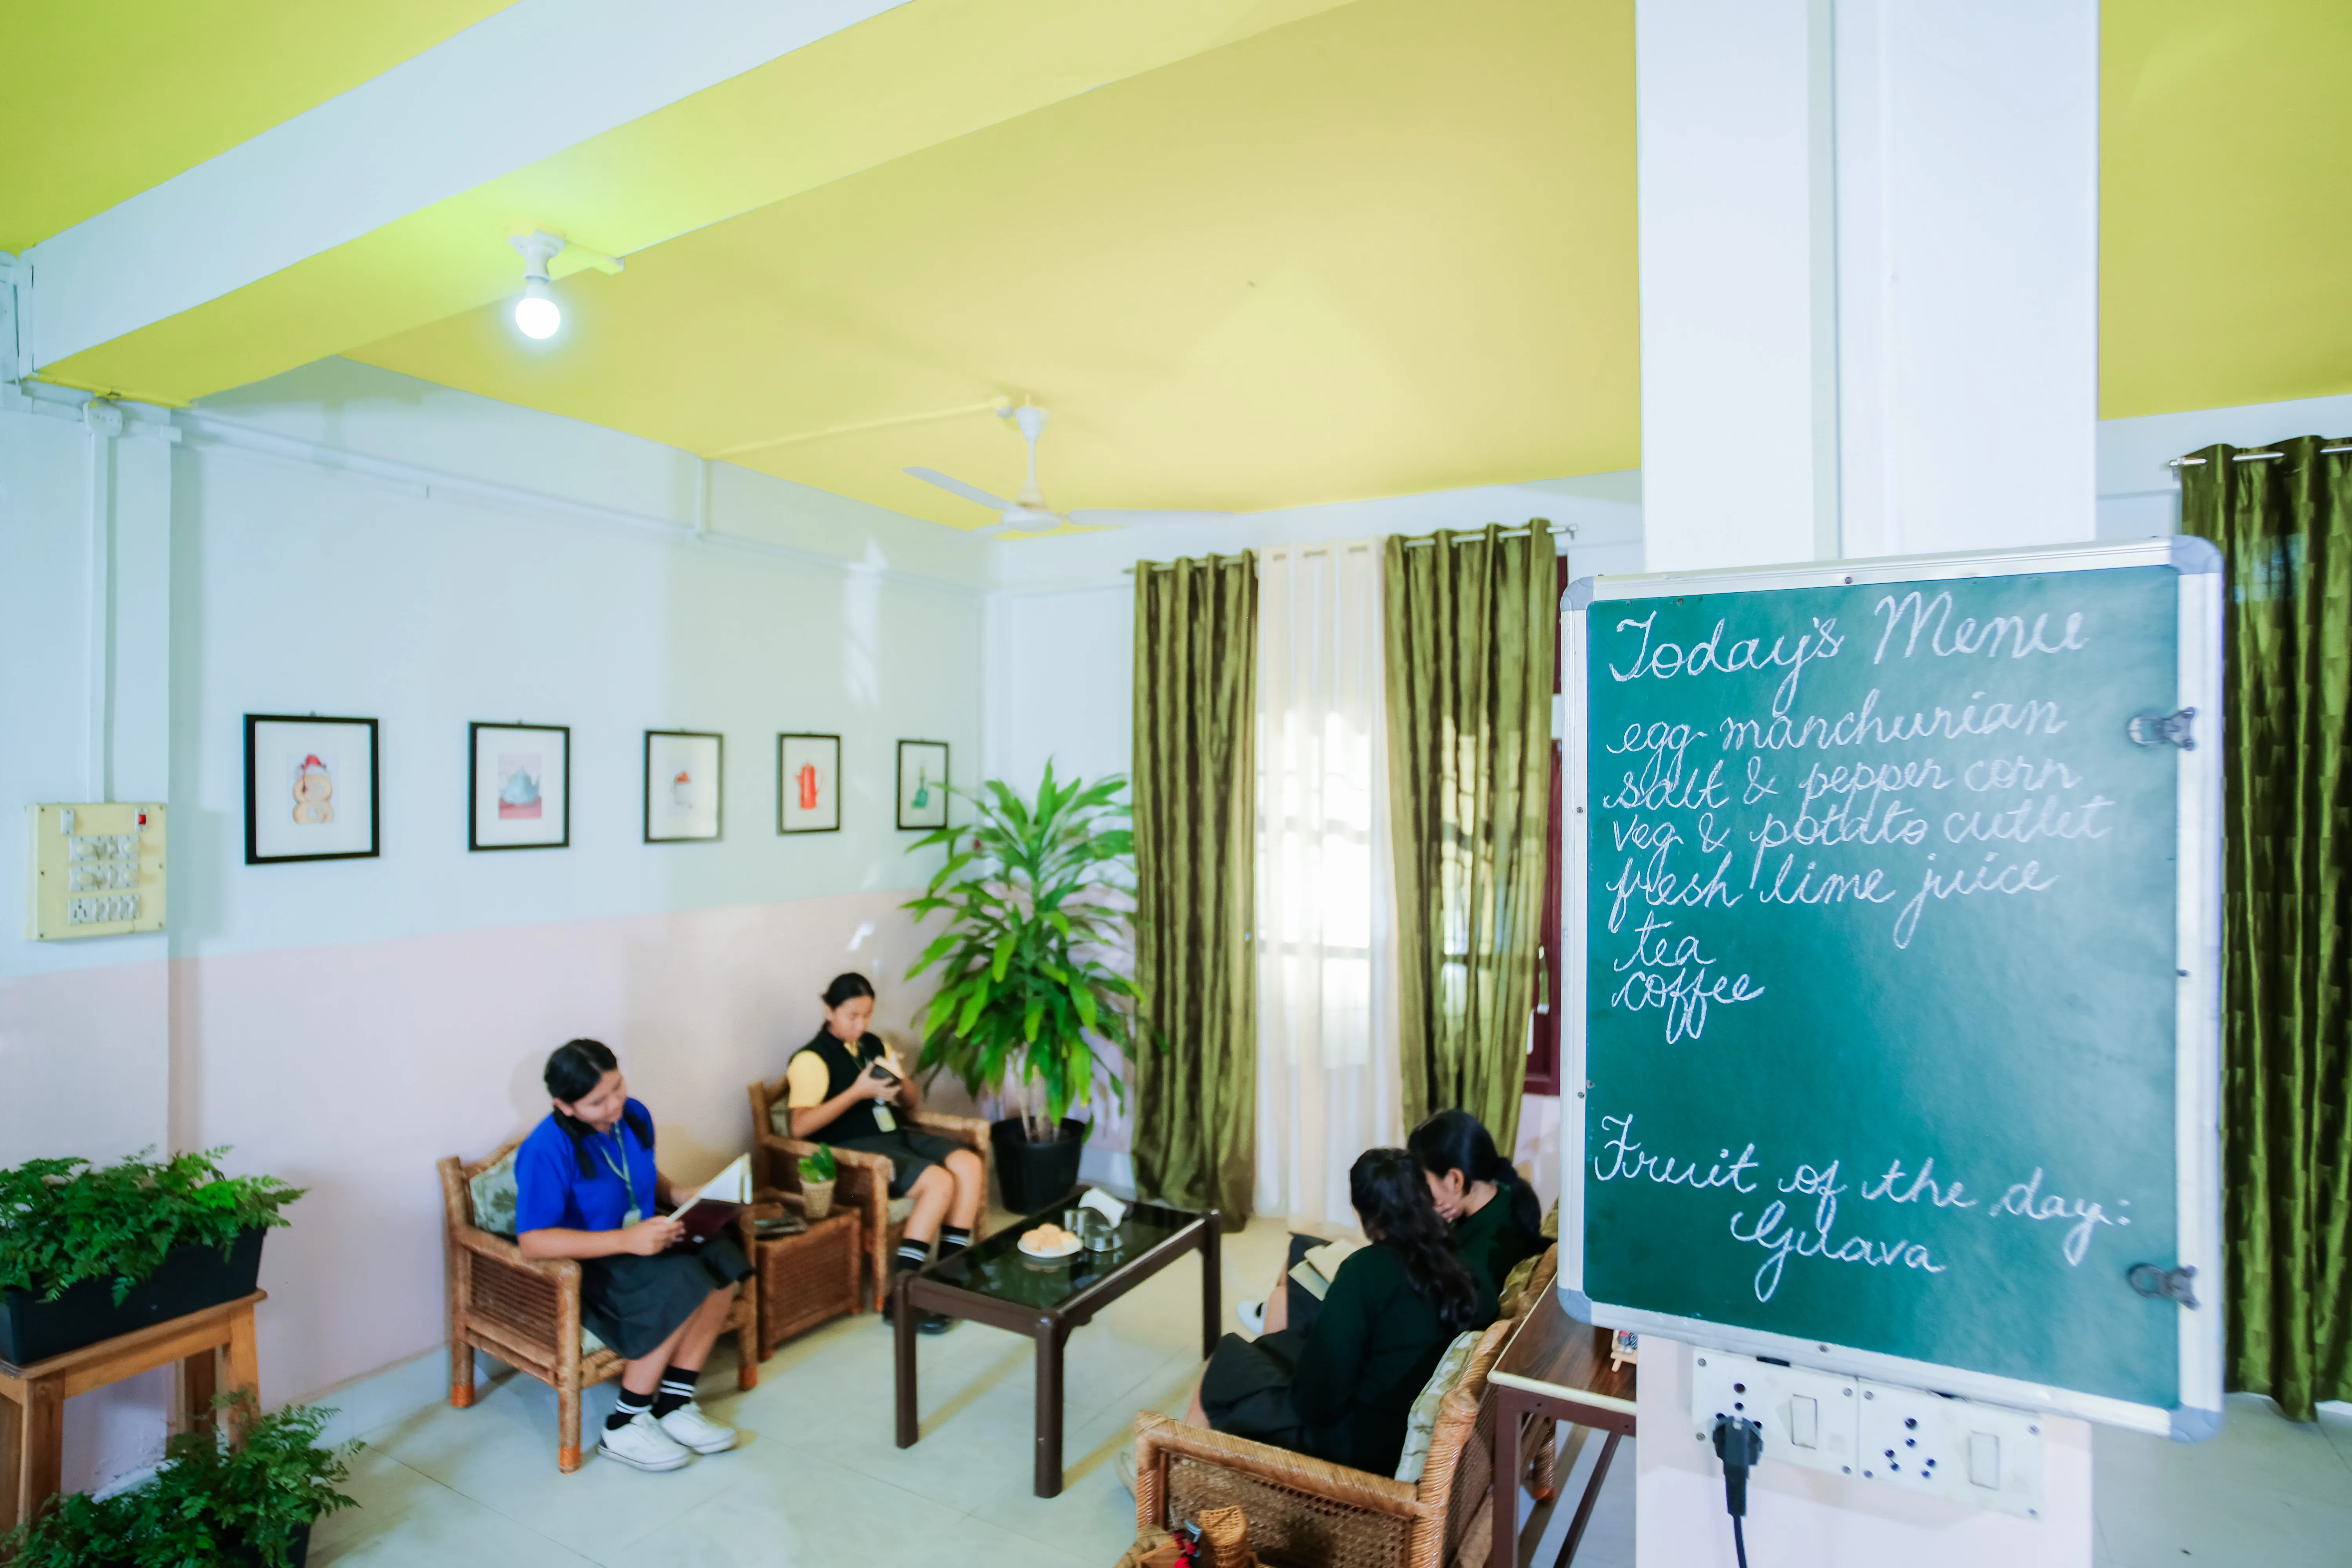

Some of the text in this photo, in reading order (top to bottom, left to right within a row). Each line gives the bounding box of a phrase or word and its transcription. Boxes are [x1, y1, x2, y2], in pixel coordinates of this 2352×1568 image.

[1608, 591, 2091, 717] Today's Menu
[1606, 688, 2068, 796] egg manchurian
[1603, 755, 2084, 833] salt & pepper corn
[1613, 794, 2116, 893] veg & potato cutlet
[1606, 850, 2062, 949] fresh lime juice
[1613, 909, 1717, 972] tea
[1611, 966, 1766, 1045] coffee
[1594, 1113, 2131, 1267] Fruit of the day:
[1730, 1200, 1947, 1303] Guava
